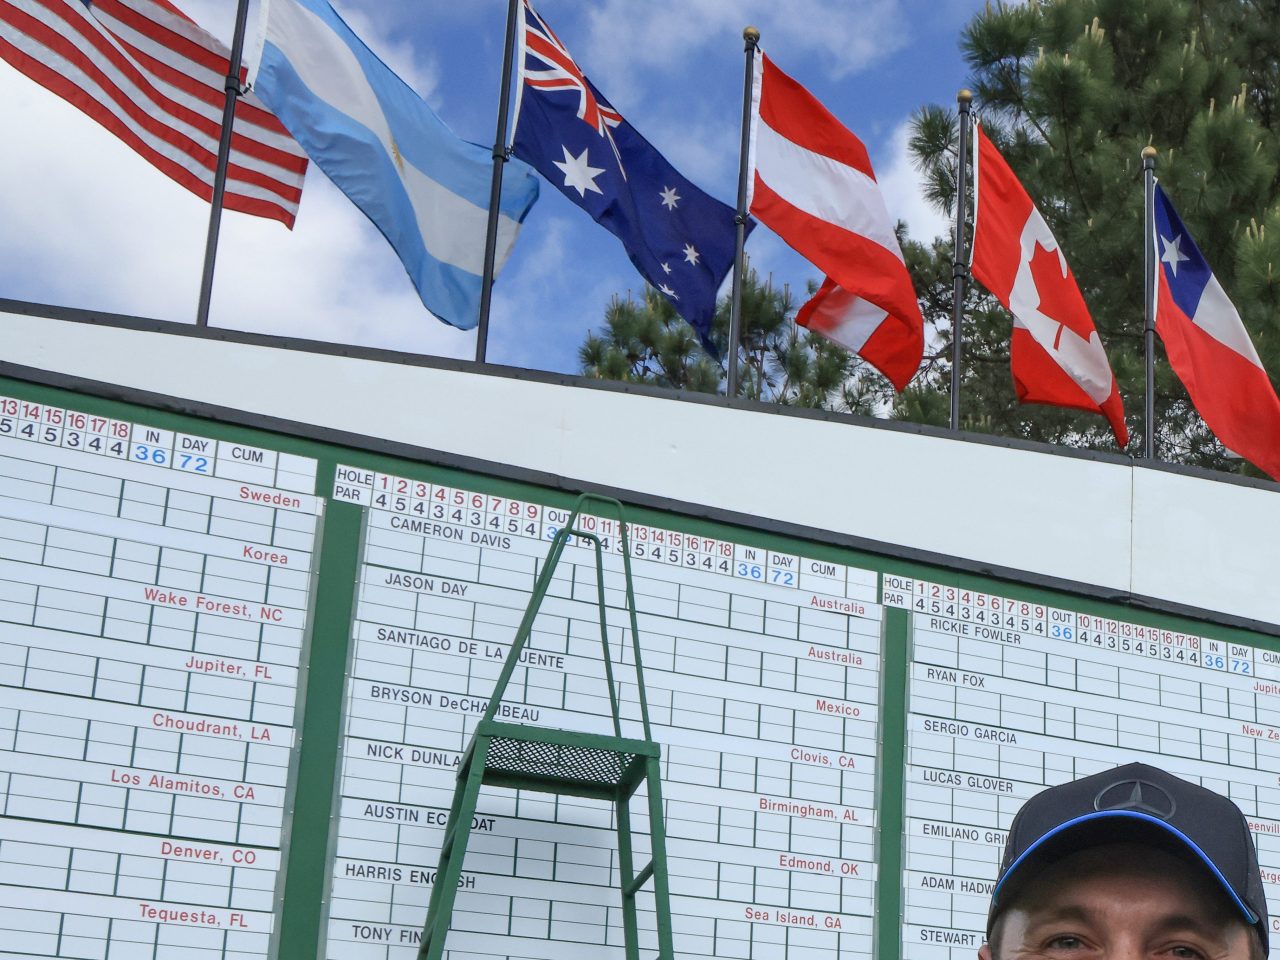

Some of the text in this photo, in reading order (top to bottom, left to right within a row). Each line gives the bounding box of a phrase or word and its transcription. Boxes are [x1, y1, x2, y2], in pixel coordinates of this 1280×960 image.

[146, 430, 263, 462] IN DAY CUM
[136, 445, 208, 472] 36 72
[240, 486, 301, 508] Sweden
[391, 517, 510, 549] CAMERON DAVIS
[243, 544, 288, 565] Korea
[385, 573, 467, 596] JASON DAY
[144, 587, 284, 622] Wake Forest, NC
[810, 595, 865, 615] Australia
[885, 577, 1072, 622] HOLE OUT
[885, 593, 1072, 640] PAR 36
[931, 619, 1020, 644] RICKIE FOWLER
[378, 628, 564, 670] SANTIAGO DE LA UENTE
[808, 647, 863, 665] Australia
[186, 656, 272, 680] Jupiter, FL
[928, 669, 984, 689] RYAN FOX
[371, 686, 432, 705] BRYSON
[816, 700, 860, 717] Mexico
[152, 713, 271, 741] Choudrant, LA
[925, 720, 1016, 744] SERGIO GARCIA
[1241, 725, 1264, 737] New
[365, 744, 460, 769] NICK DUNLA
[790, 748, 856, 768] Clovis, CA
[111, 770, 256, 800] Los Alamitos, CA
[924, 770, 1012, 793] LUCAS GLOVER
[364, 805, 418, 823] AUSTIN
[759, 796, 858, 821] Birmingham, AL
[924, 824, 978, 841] EMILIANO
[161, 841, 256, 864] Denver, CO
[346, 864, 401, 881] HARRIS
[779, 854, 859, 876] Edmond, OK
[922, 877, 954, 890] ADAM
[140, 903, 247, 928] Tequesta, FL
[745, 907, 842, 929] Sea Island, GA
[352, 925, 392, 942] TONY
[921, 929, 976, 945] STEWART
